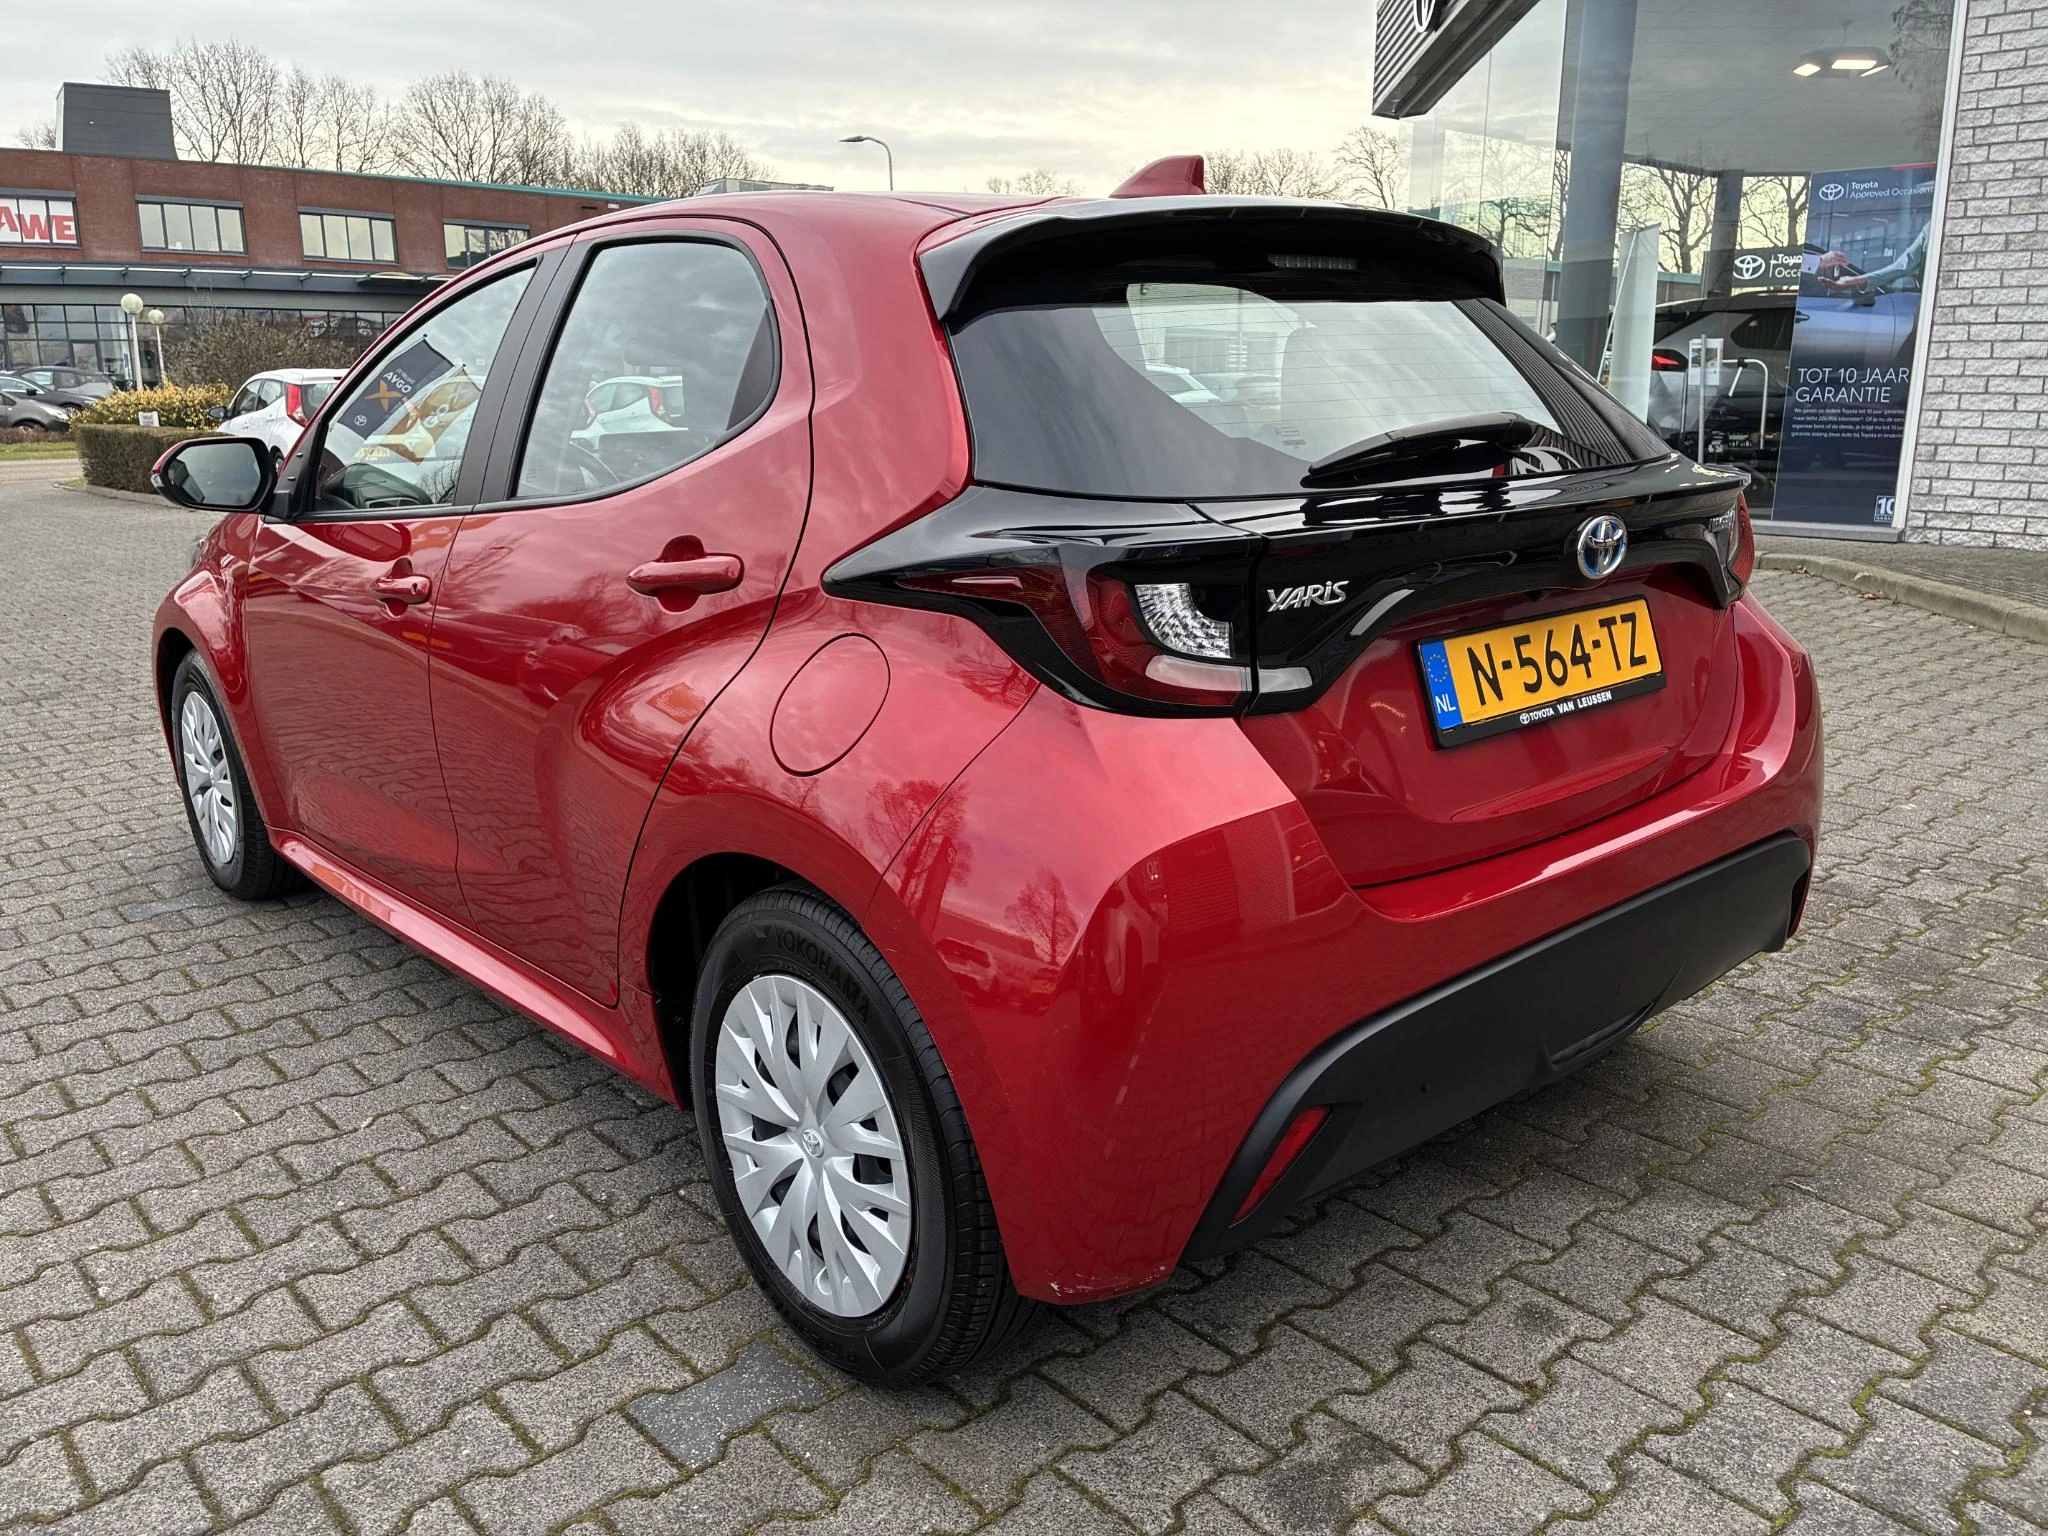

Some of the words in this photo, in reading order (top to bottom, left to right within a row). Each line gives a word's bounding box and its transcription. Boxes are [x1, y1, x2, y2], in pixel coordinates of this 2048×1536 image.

[1850, 188, 1889, 200] Approved
[1851, 181, 1878, 190] Toyota
[1777, 254, 1802, 266] Toyo
[1798, 368, 1832, 384] TOT
[1838, 368, 1857, 384] 10
[1862, 367, 1909, 384] JAAR
[1795, 386, 1891, 403] GARANTIE
[1466, 612, 1648, 706] N-564-TZ
[1435, 693, 1456, 714] NL
[1529, 707, 1555, 721] TOYOTA
[1557, 701, 1575, 714] VAN
[1577, 691, 1612, 709] LEUSSEN
[774, 926, 871, 1024] YOKOHAMA
